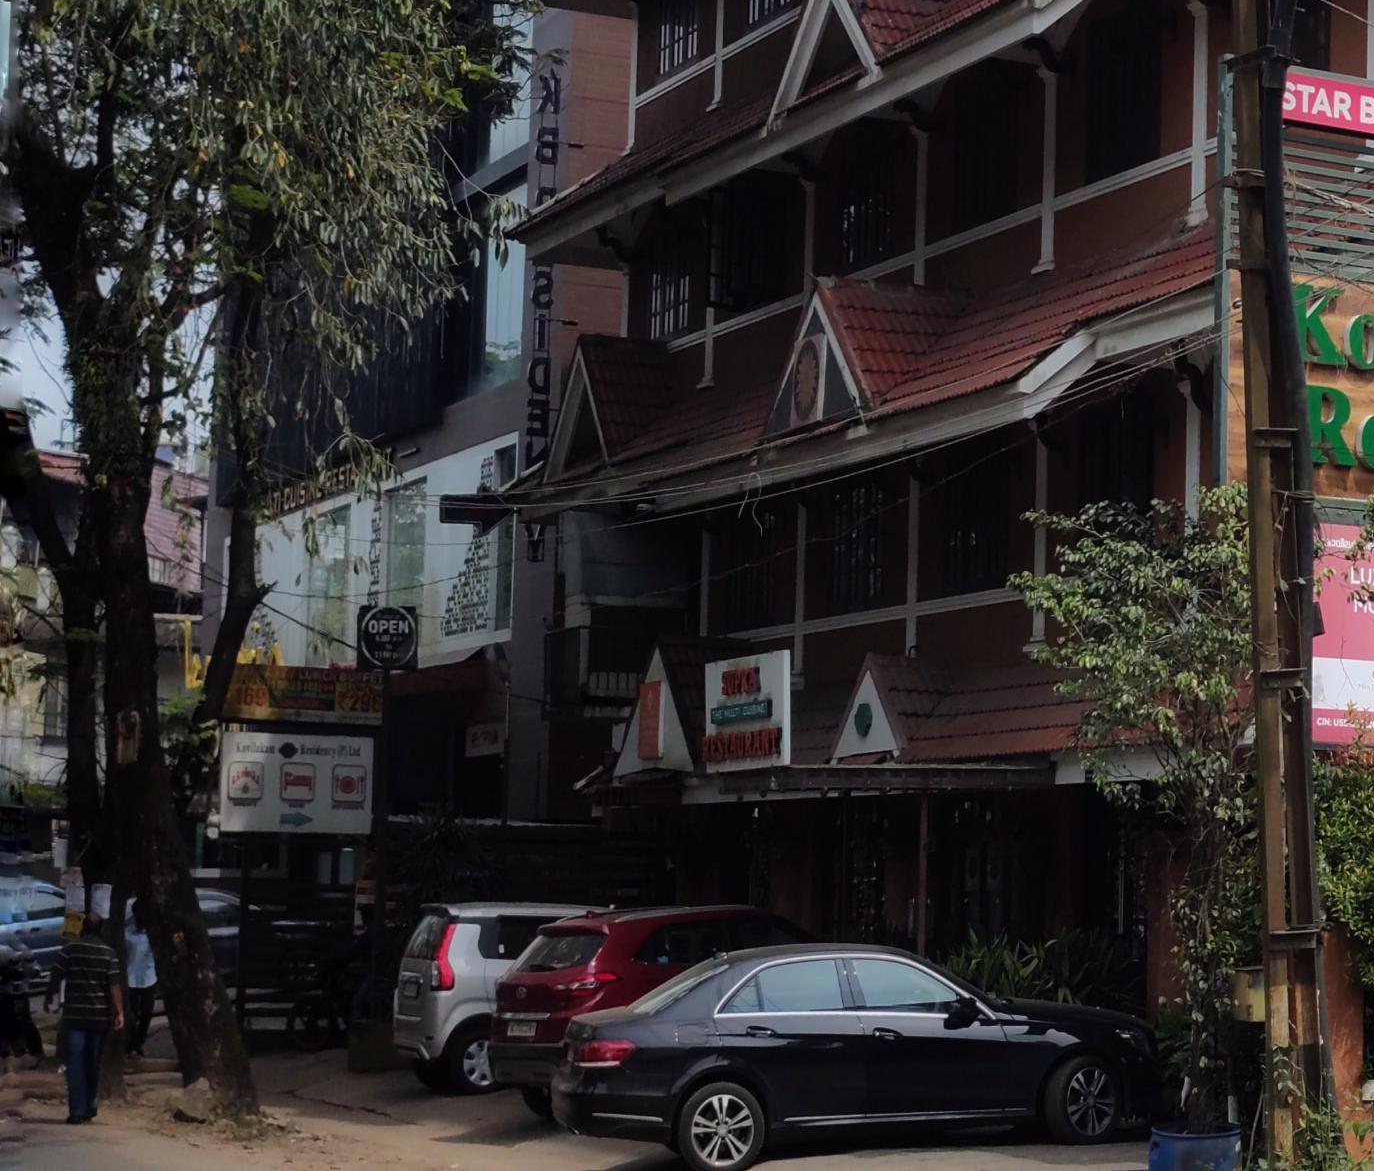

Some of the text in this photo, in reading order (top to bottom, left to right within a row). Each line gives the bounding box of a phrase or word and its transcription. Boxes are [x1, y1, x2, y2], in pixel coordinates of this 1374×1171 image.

[1283, 81, 1352, 120] STAR
[368, 619, 409, 634] OPEN
[1317, 717, 1332, 726] CIN:
[703, 727, 782, 762] RESTAURANT
